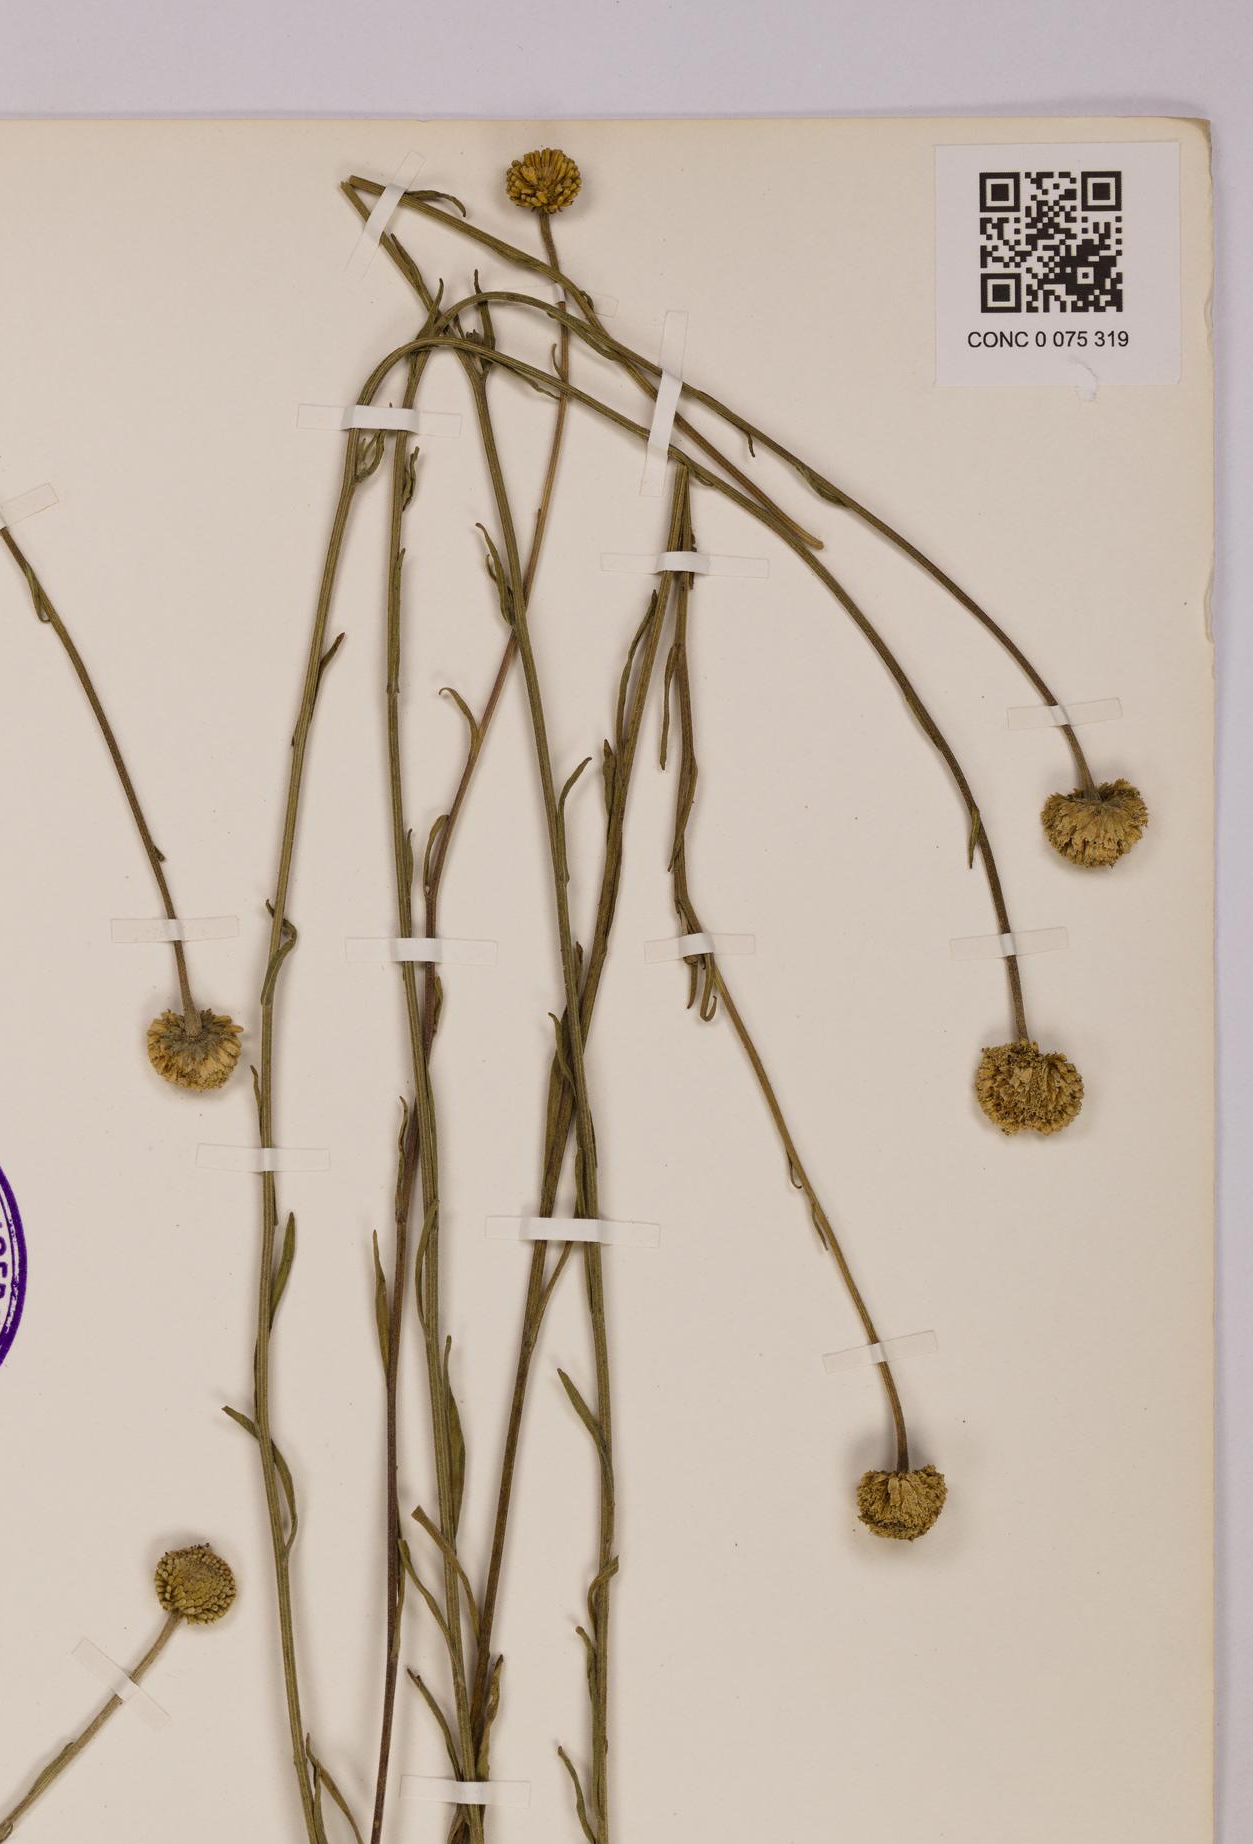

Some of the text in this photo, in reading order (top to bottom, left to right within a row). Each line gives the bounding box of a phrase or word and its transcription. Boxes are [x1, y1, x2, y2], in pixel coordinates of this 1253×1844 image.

[967, 330, 1130, 349] CONC 0 075 319
